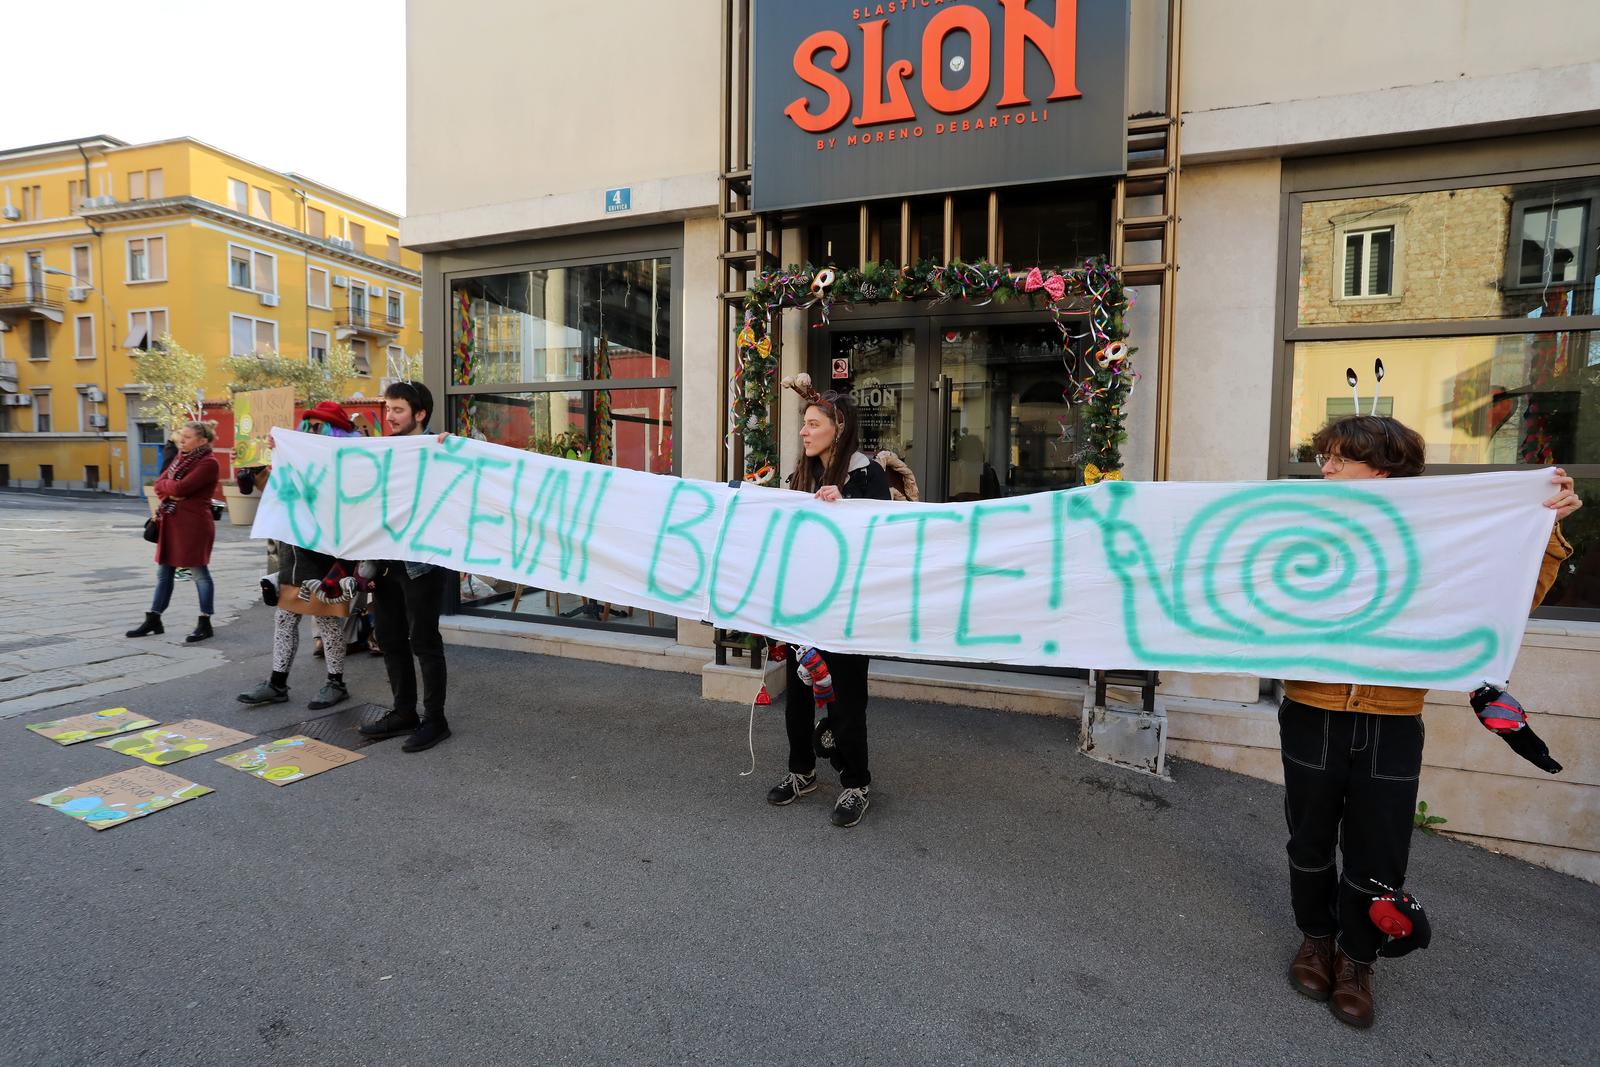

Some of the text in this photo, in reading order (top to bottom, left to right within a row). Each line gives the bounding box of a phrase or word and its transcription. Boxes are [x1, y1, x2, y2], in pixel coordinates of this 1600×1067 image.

[783, 0, 1083, 133] SLON
[816, 108, 1050, 151] BY MORENO DEBARTOLI
[613, 191, 621, 204] 4
[848, 389, 895, 406] SLON
[334, 434, 1066, 654] PUŽEVNI BUDITE!
